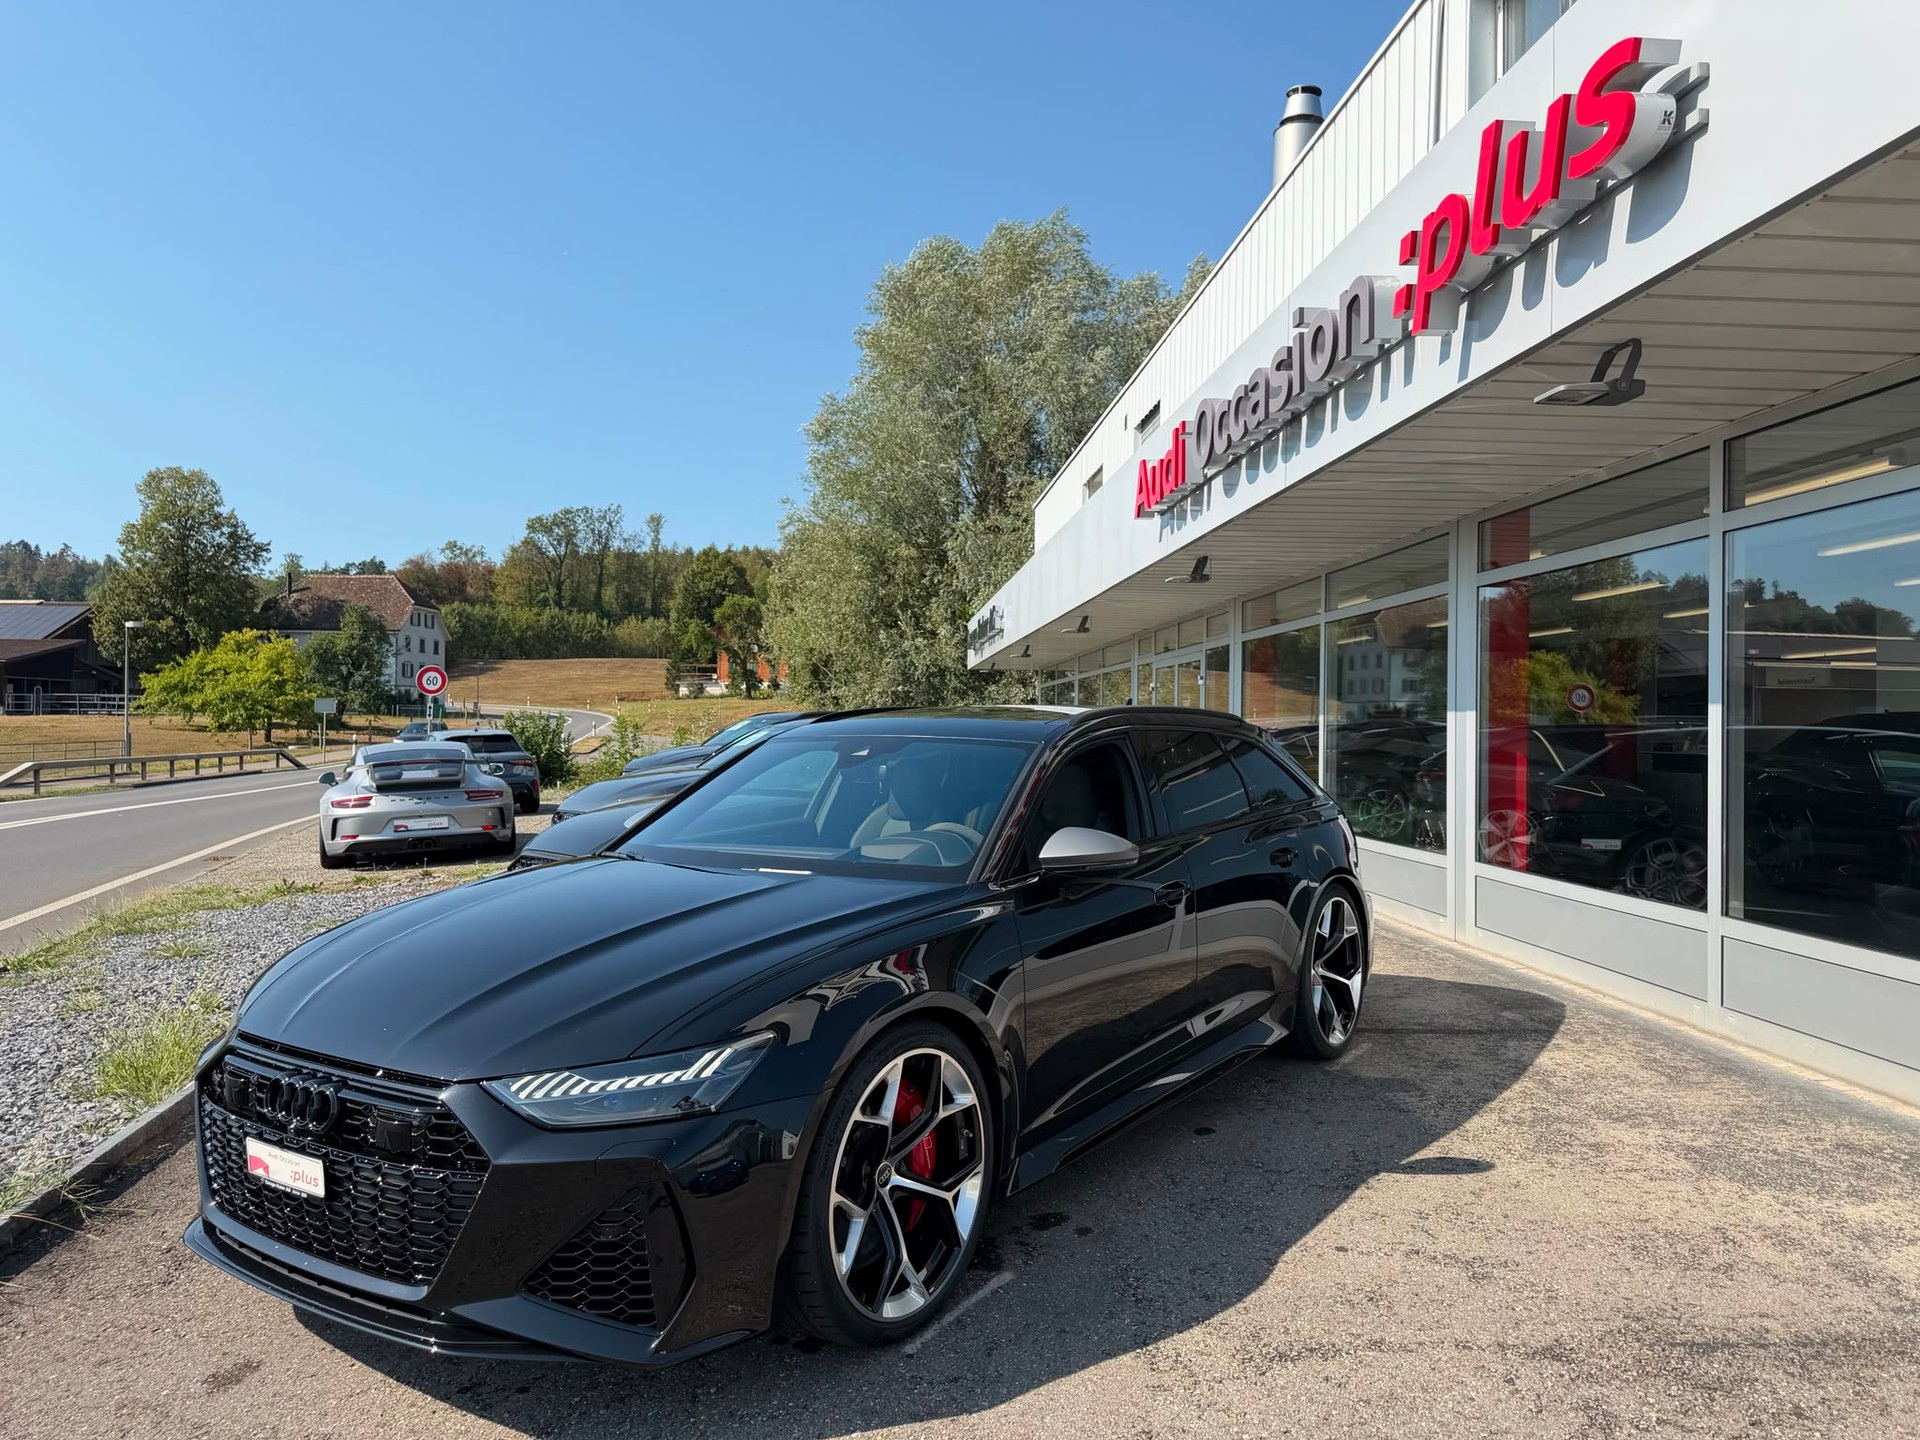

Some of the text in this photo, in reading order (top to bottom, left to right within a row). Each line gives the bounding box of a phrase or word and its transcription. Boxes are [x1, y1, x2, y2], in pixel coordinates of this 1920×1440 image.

[1134, 37, 1643, 520] Audi Occasion :plus
[426, 676, 438, 686] 60
[290, 1170, 319, 1187] :plus
